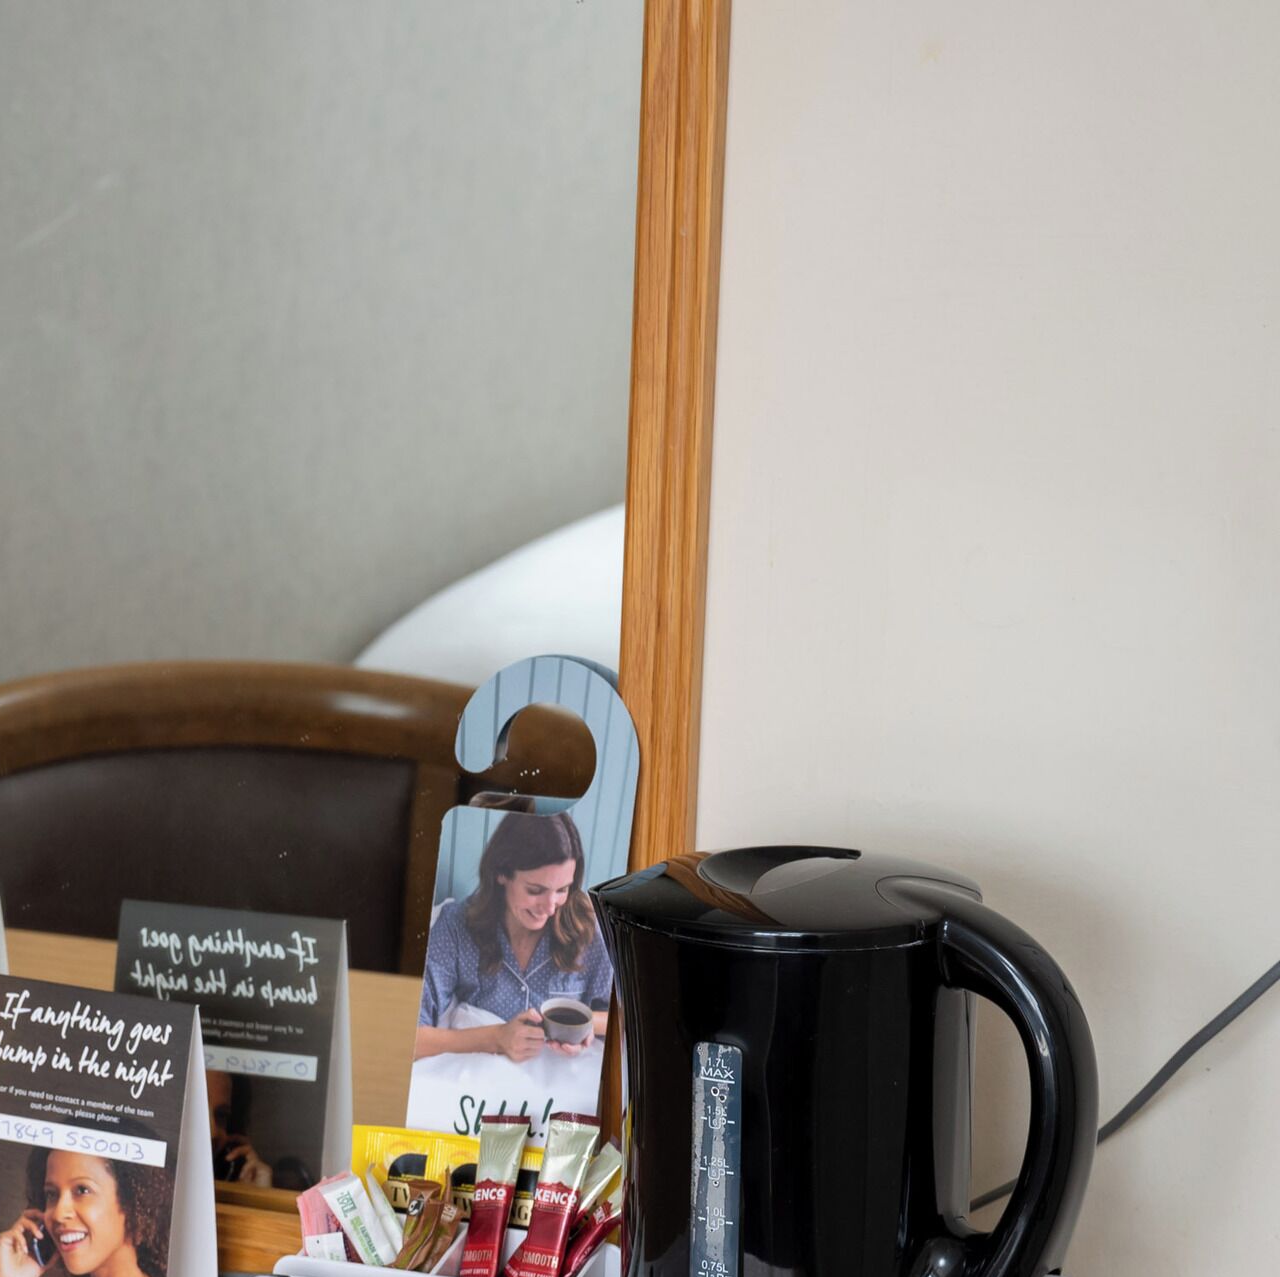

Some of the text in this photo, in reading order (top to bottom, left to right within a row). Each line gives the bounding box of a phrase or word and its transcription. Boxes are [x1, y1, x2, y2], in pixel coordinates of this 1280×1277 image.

[0, 990, 172, 1054] If anything goes
[52, 1047, 73, 1071] in
[78, 1047, 110, 1078] the
[115, 1060, 174, 1099] night
[701, 1066, 734, 1080] MAX
[14, 1089, 26, 1097] you
[28, 1090, 44, 1098] need
[55, 1094, 79, 1105] contact
[87, 1100, 114, 1110] member
[115, 1104, 123, 1112] of
[124, 1105, 135, 1114] the
[137, 1108, 154, 1117] team
[75, 1110, 95, 1120] please
[66, 1131, 145, 1160] 550013
[703, 1155, 730, 1169] 1.25L
[535, 1188, 578, 1205] KENCO
[522, 1251, 559, 1269] SMOOTH
[702, 1260, 729, 1273] 0.75L
